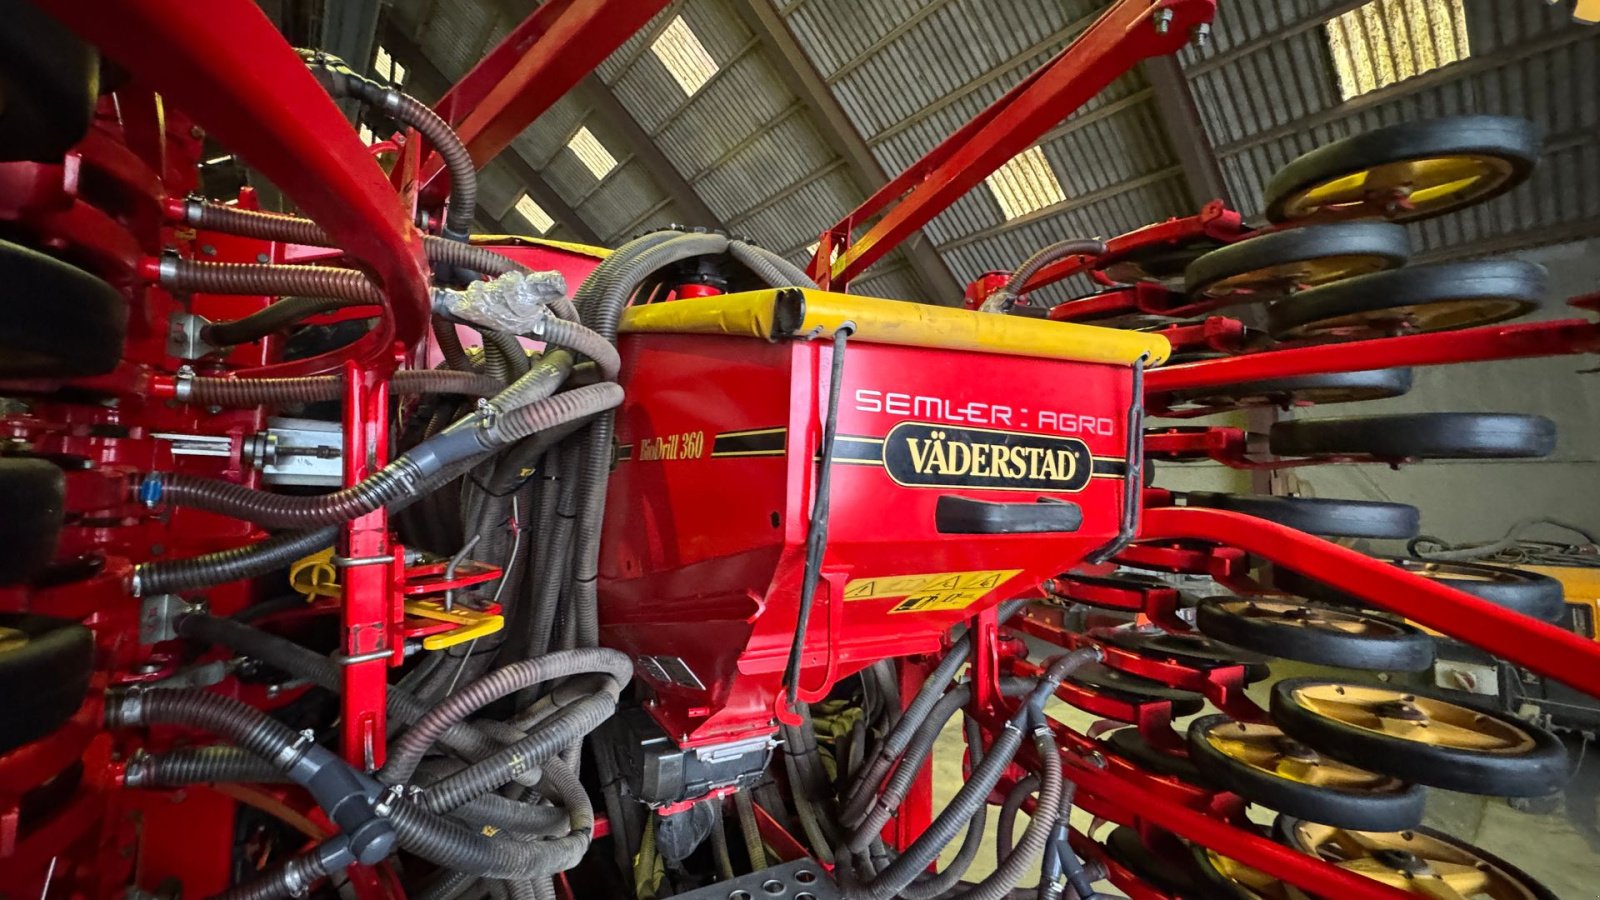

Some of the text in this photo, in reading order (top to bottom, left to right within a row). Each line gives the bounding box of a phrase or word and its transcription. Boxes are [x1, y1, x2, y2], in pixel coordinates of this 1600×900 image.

[855, 389, 1012, 426] SEMLER
[1038, 410, 1114, 436] AGRO
[639, 431, 704, 461] BioDrill 360
[906, 431, 1080, 481] VÄDERSTAD
